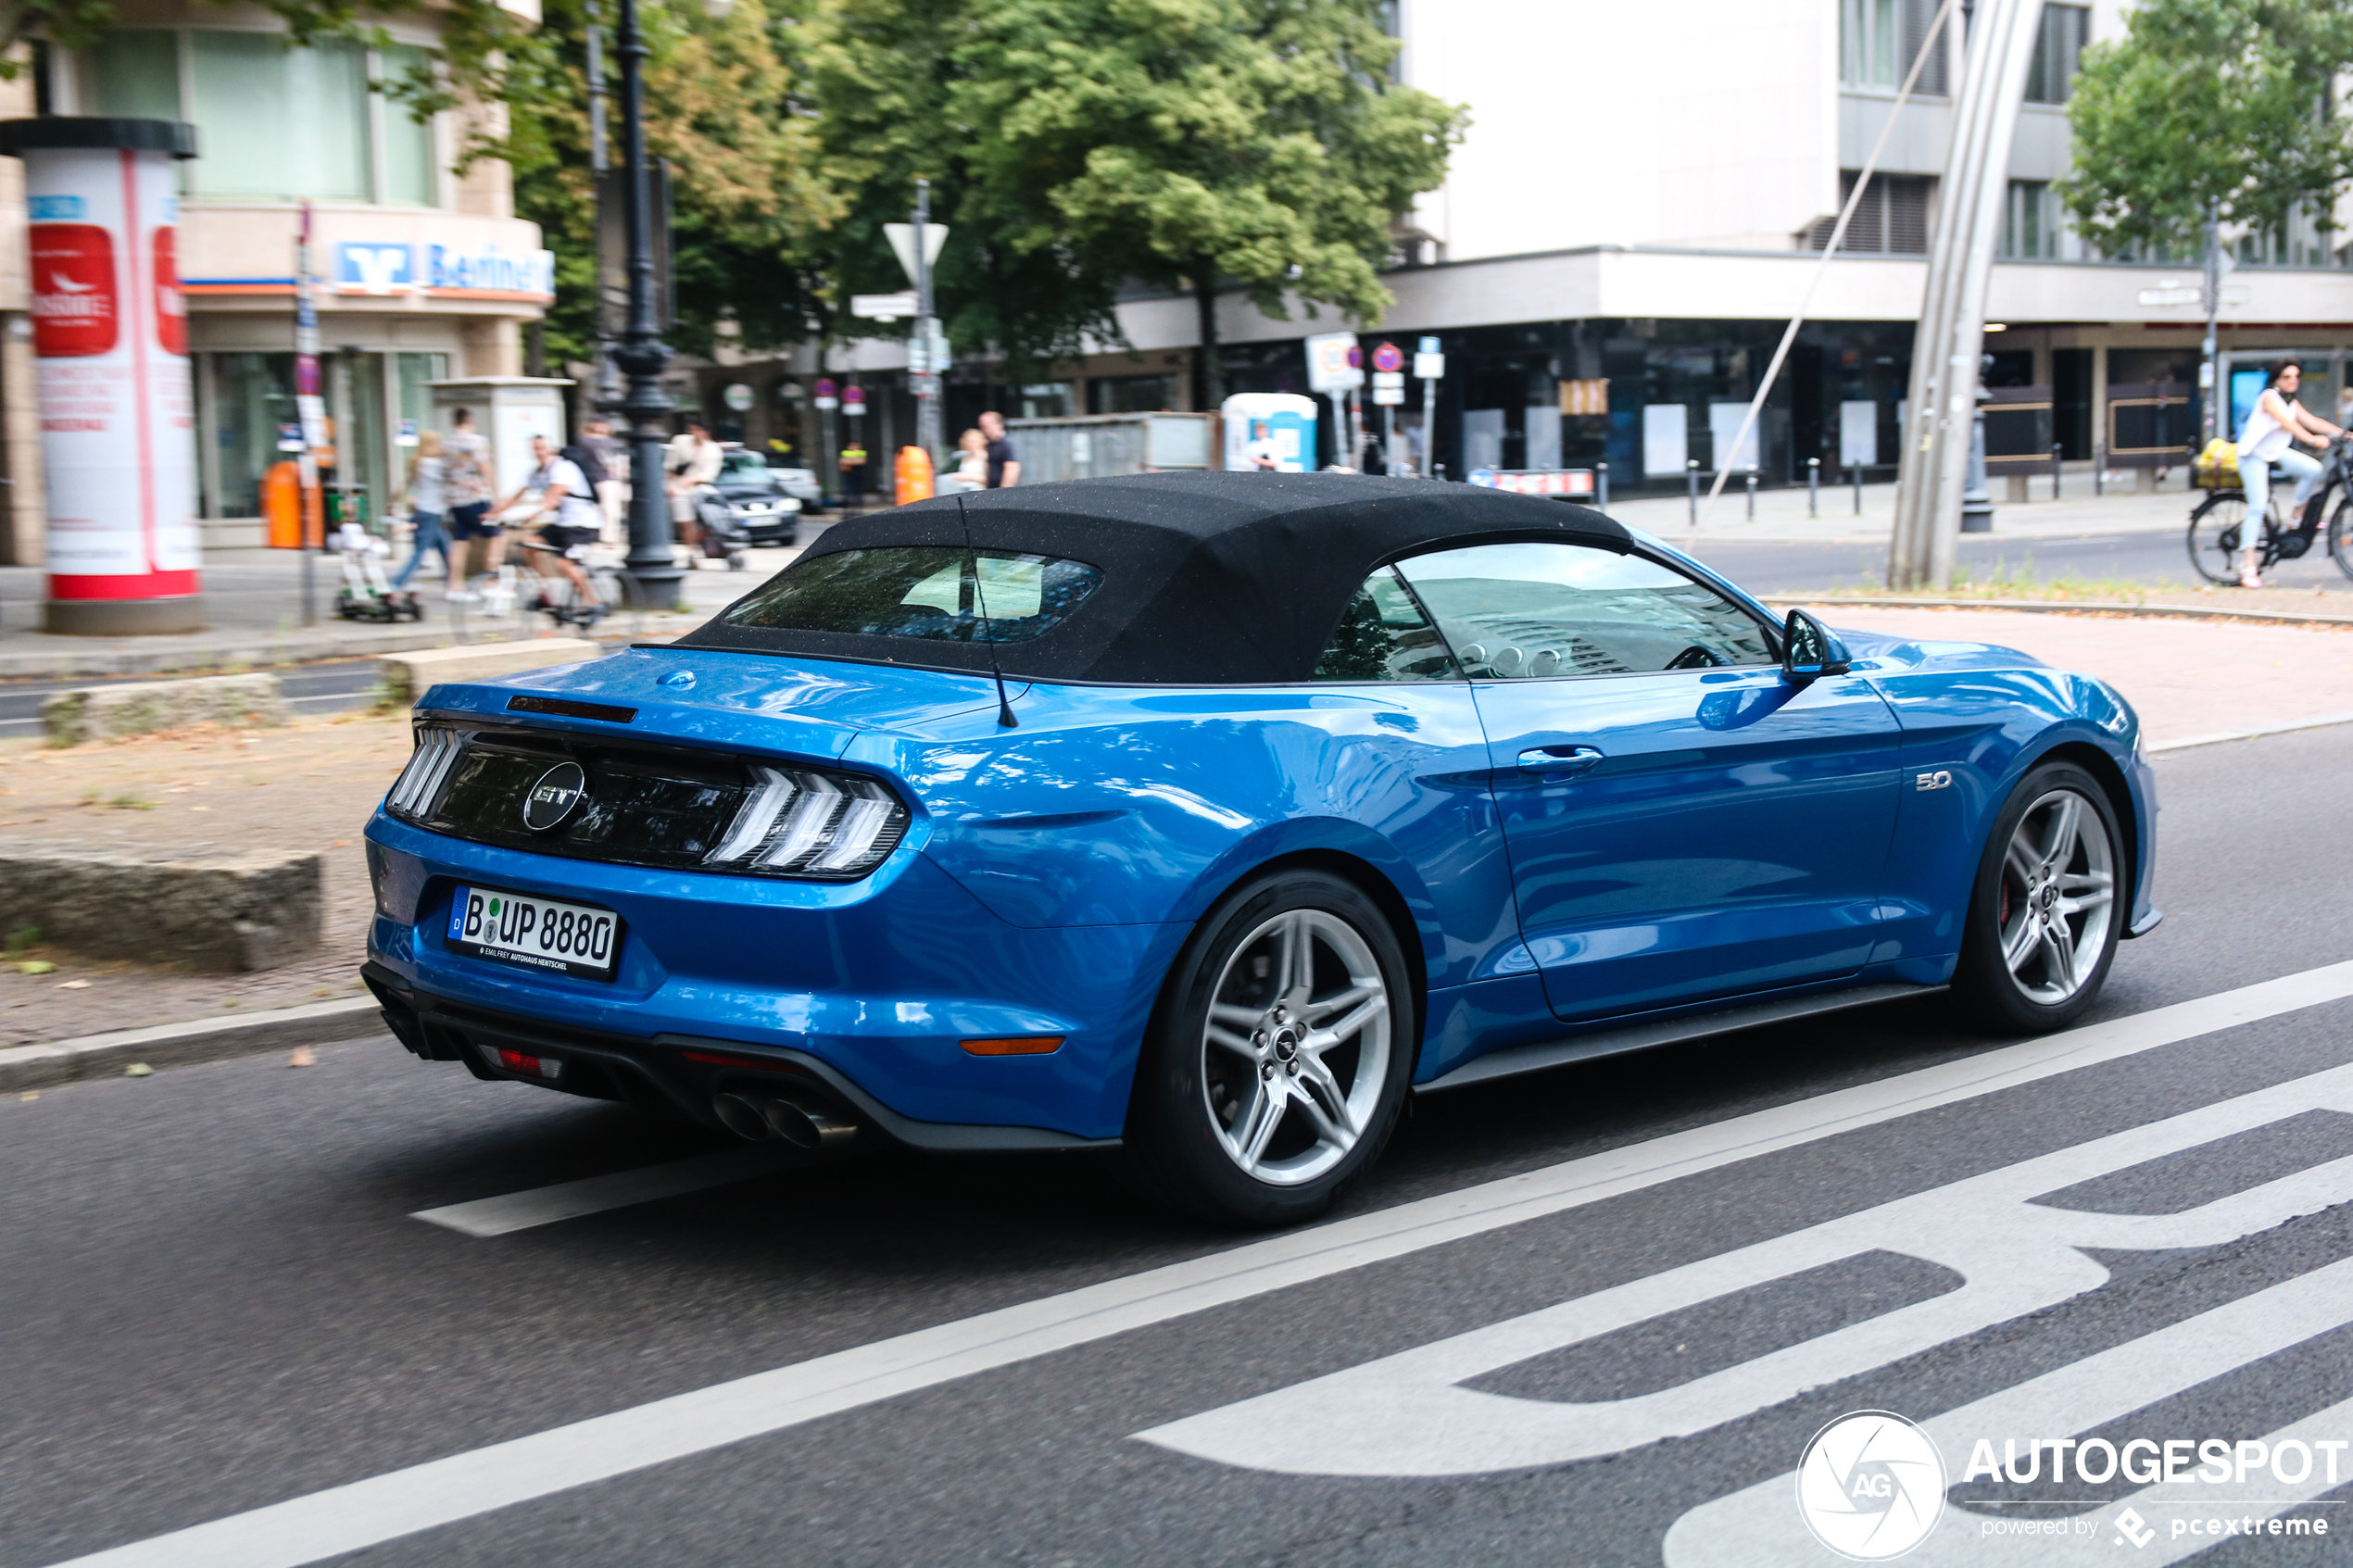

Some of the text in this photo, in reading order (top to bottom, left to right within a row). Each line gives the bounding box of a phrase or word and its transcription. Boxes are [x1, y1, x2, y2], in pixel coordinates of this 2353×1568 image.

[1916, 770, 1952, 792] 5.0
[453, 918, 461, 930] D
[464, 894, 611, 960] B UP 8880
[484, 947, 568, 971] EMIL FREY AUTOHAUS HENTSCHEL
